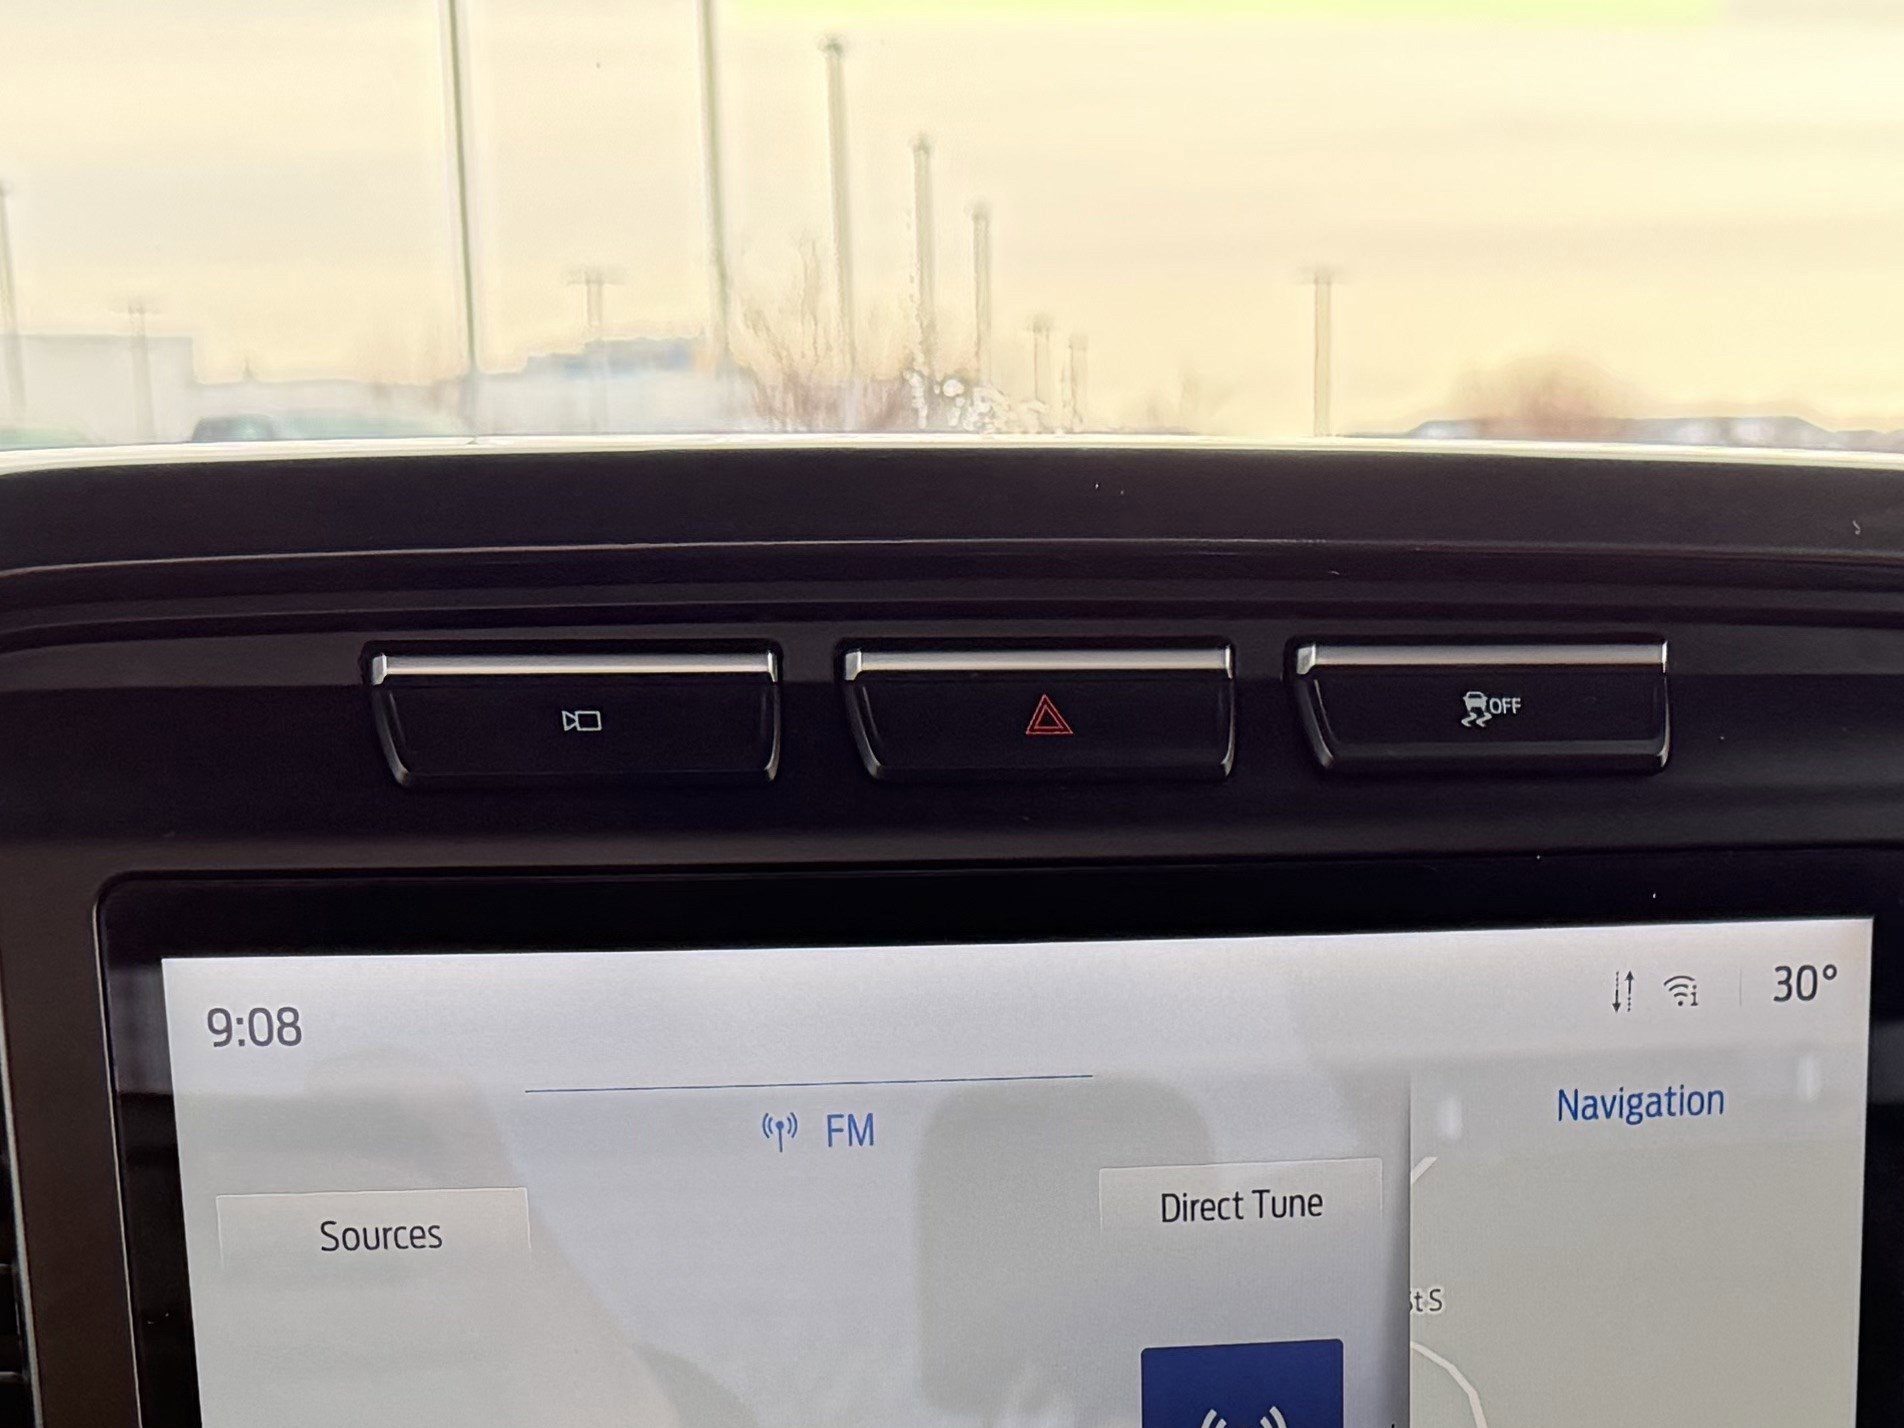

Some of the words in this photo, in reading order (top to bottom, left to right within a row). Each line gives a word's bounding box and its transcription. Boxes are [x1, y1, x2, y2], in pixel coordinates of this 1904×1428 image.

[1488, 697, 1522, 715] OFF
[1772, 963, 1839, 1003] 30°
[205, 1006, 303, 1049] 9:08
[1556, 1085, 1726, 1125] Navigation
[826, 1113, 876, 1148] FM
[1160, 1191, 1245, 1224] Direct
[1252, 1188, 1325, 1221] Tune
[319, 1219, 444, 1253] Sources
[1428, 1288, 1444, 1312] S
